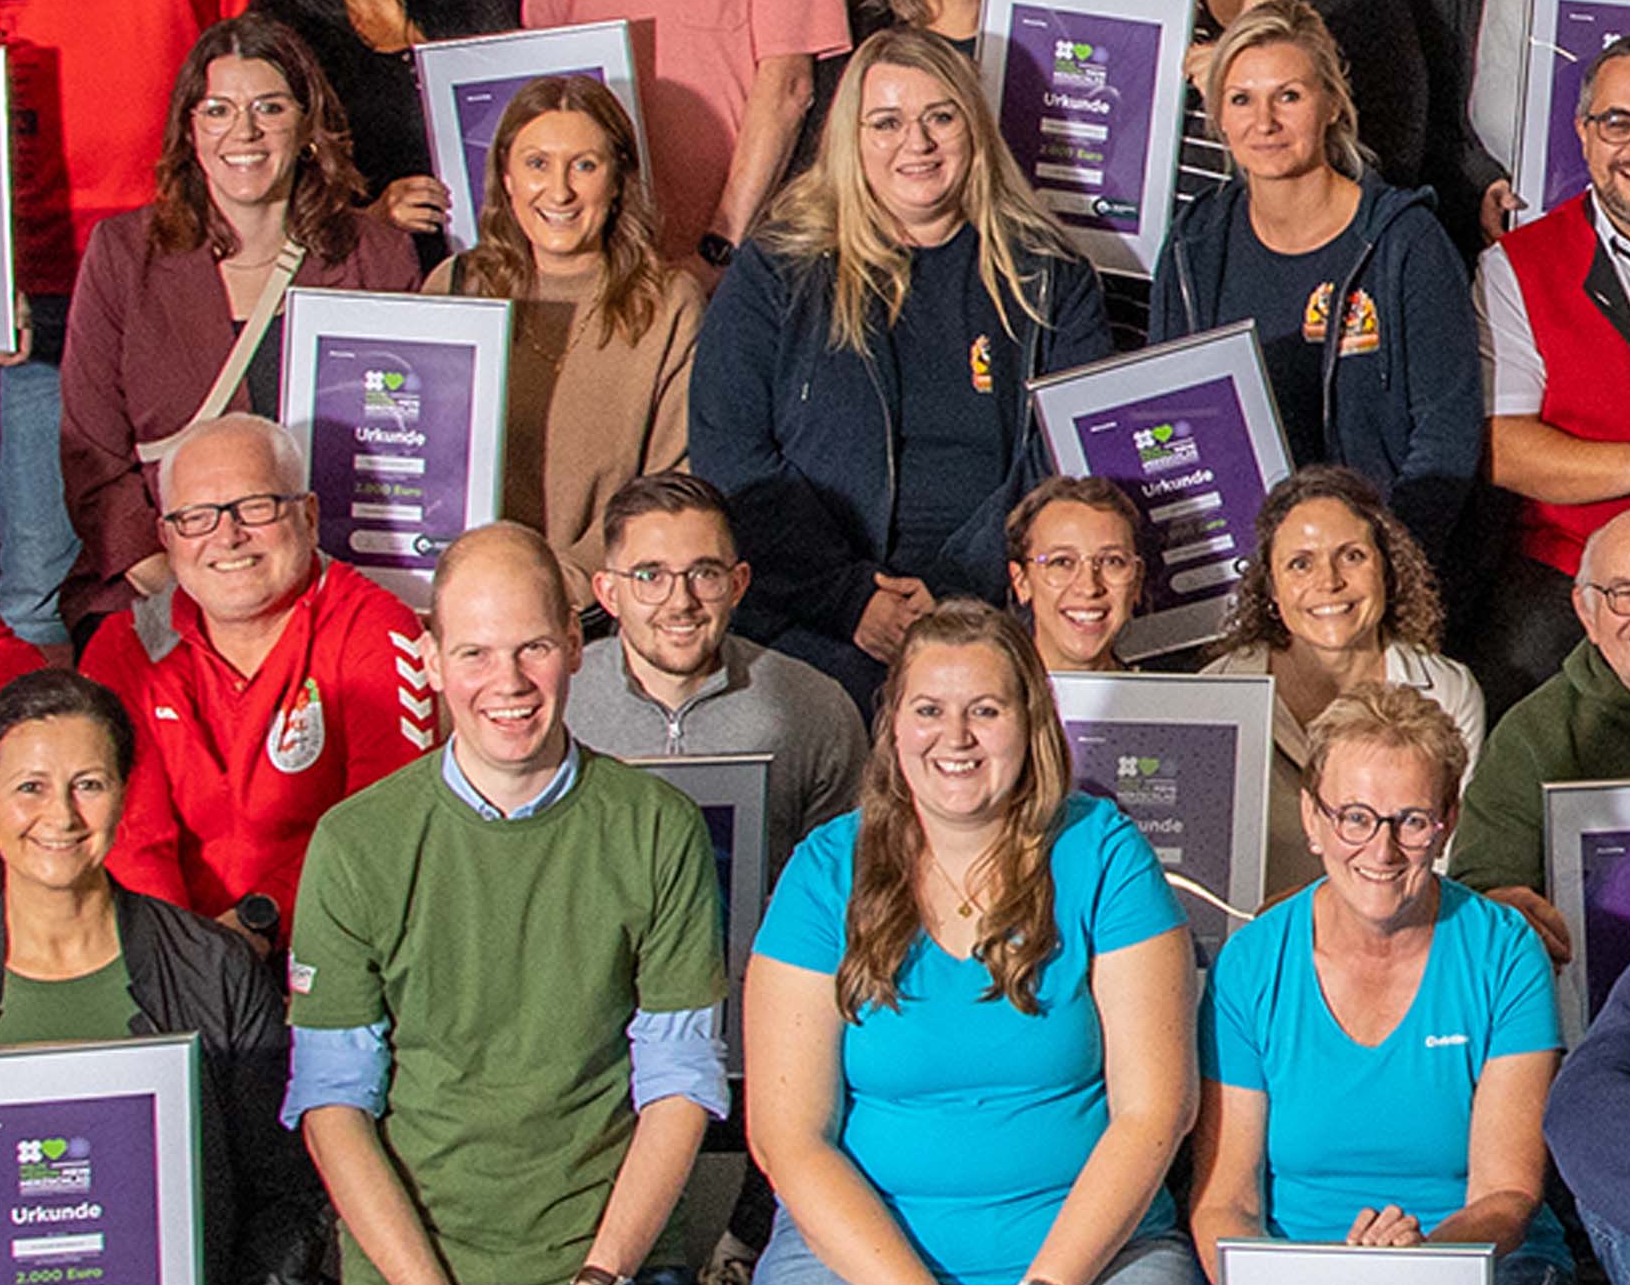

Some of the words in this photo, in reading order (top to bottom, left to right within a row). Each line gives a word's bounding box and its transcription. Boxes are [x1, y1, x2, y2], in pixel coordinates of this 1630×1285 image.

[1044, 92, 1110, 114] Urkunde
[355, 427, 425, 446] Urkunde
[1142, 470, 1214, 496] Urkunde
[11, 1202, 102, 1224] Urkunde
[16, 1270, 62, 1284] 2.000
